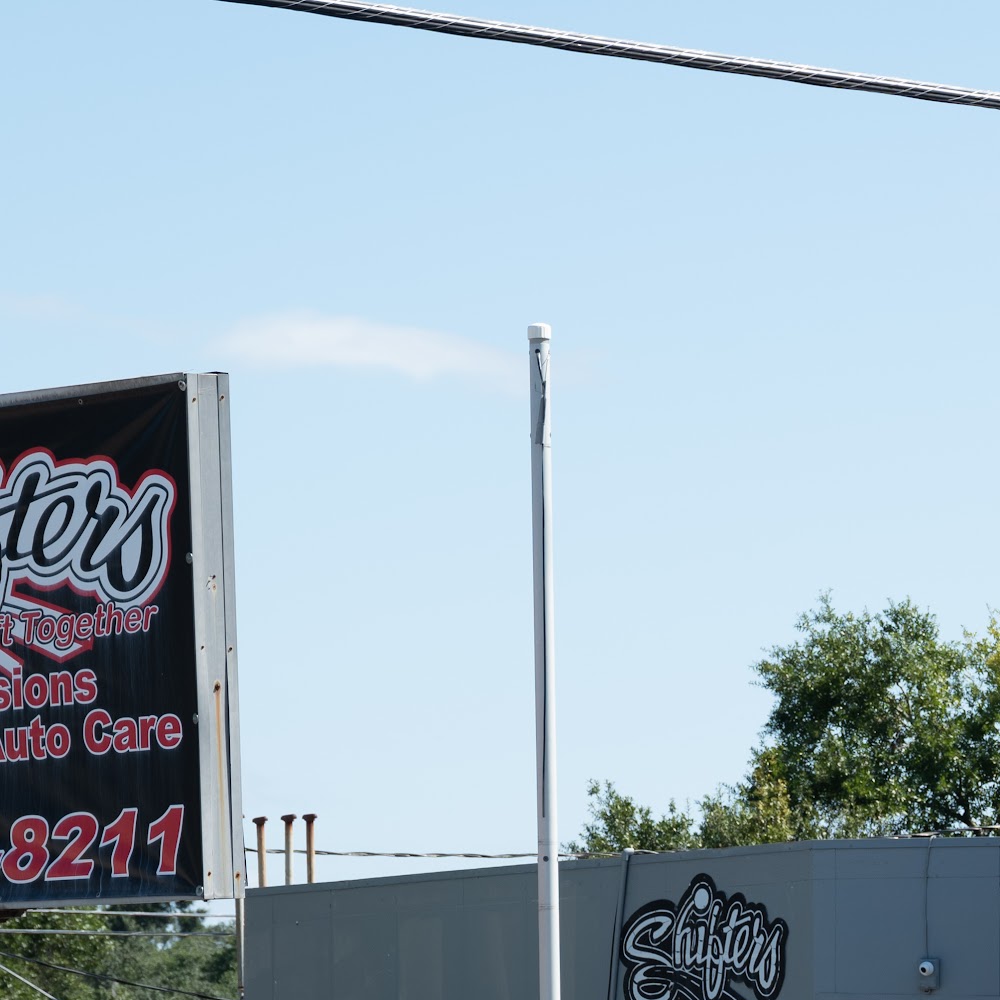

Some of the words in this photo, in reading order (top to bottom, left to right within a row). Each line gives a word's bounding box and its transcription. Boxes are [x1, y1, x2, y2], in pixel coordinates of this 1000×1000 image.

[0, 458, 172, 602] ters
[20, 602, 159, 649] Together
[0, 714, 71, 763] uto
[83, 708, 183, 755] Care
[0, 804, 184, 884] 8211
